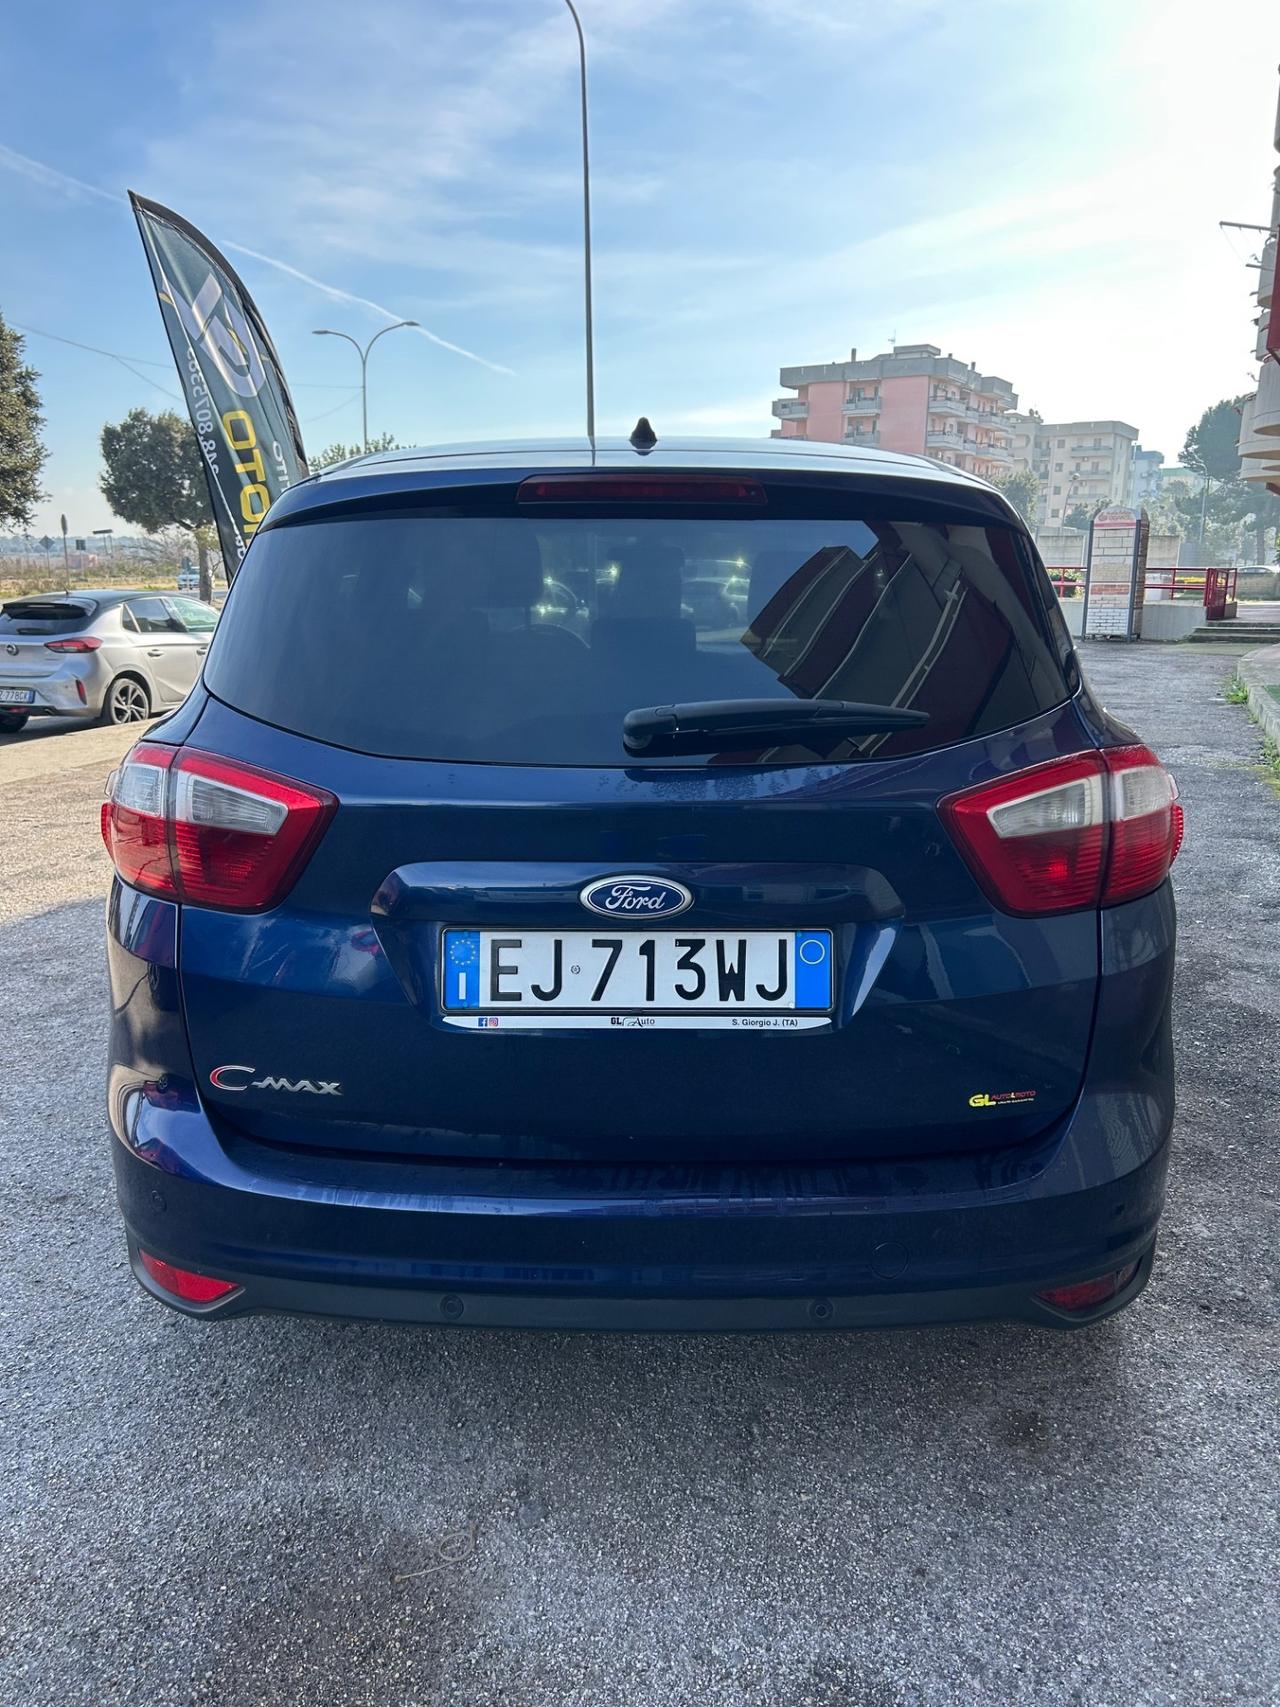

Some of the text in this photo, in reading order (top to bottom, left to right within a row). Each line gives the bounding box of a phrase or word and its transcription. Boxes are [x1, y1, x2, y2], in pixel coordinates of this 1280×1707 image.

[605, 885, 665, 910] Ford
[490, 939, 788, 1002] EJ 713WJ
[732, 1018, 740, 1026] S.
[742, 1018, 771, 1028] Giorgio
[782, 1018, 798, 1027] (TA)
[968, 1094, 996, 1107] GL
